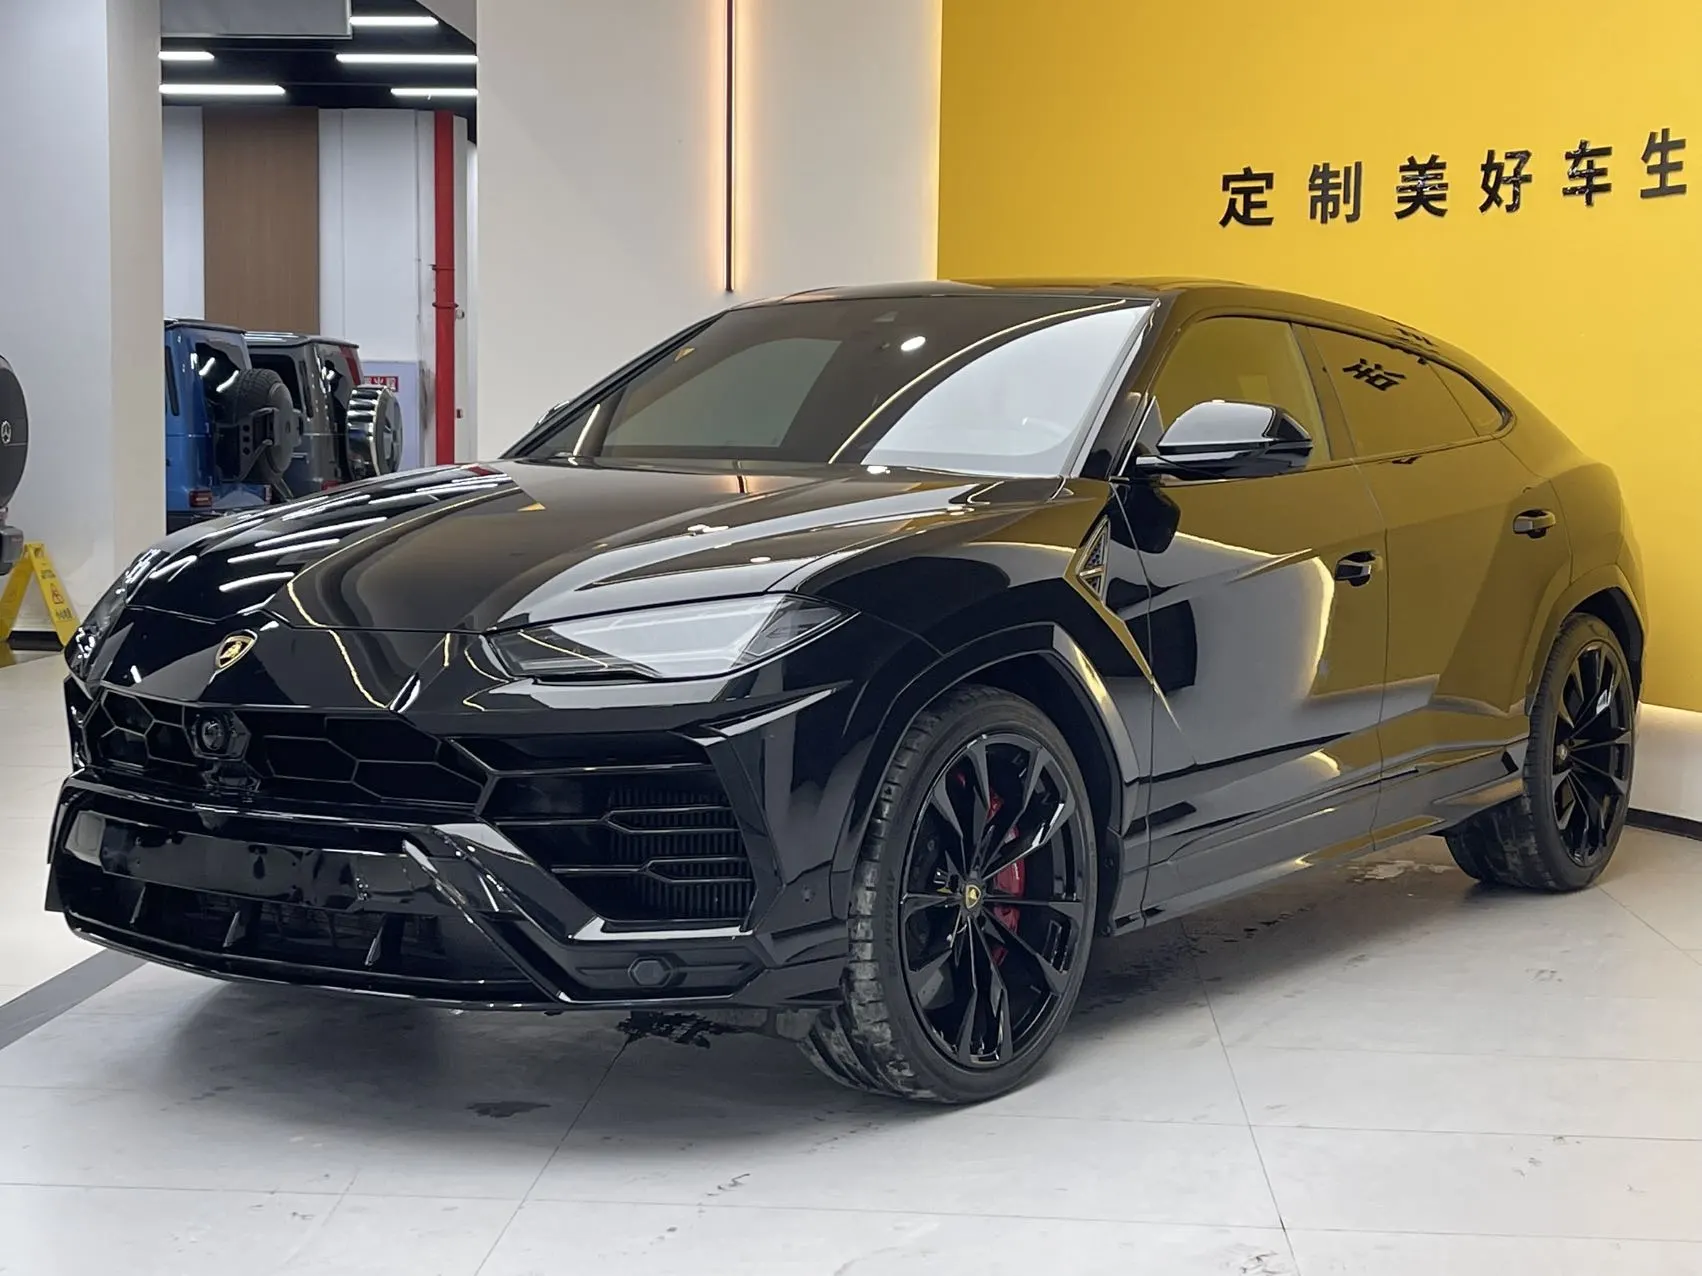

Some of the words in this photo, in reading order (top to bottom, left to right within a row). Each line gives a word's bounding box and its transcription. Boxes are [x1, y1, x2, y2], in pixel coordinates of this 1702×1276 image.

[1219, 128, 1687, 228] 定制美好车生
